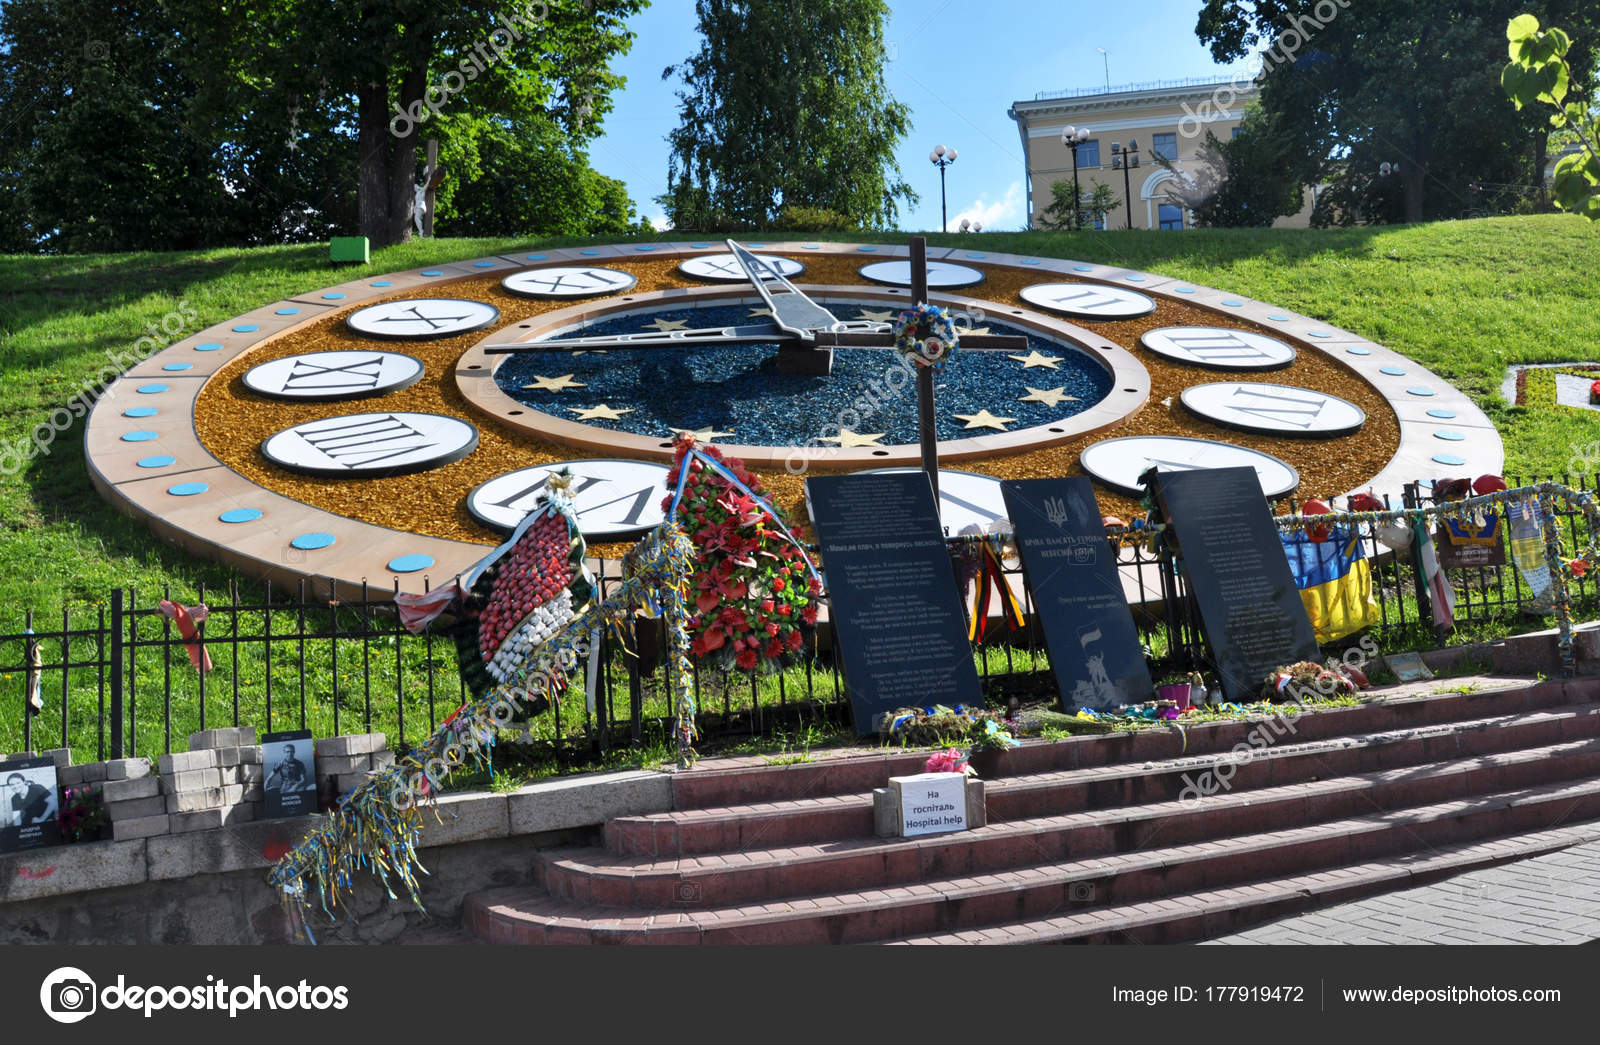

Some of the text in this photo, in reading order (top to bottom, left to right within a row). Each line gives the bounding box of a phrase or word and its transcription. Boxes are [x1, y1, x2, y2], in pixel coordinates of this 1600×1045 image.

[520, 270, 618, 292] XI
[373, 307, 474, 330] X
[1167, 336, 1272, 361] III
[927, 791, 939, 799] На
[913, 803, 955, 814] госпіталь
[906, 815, 963, 829] Hospital help
